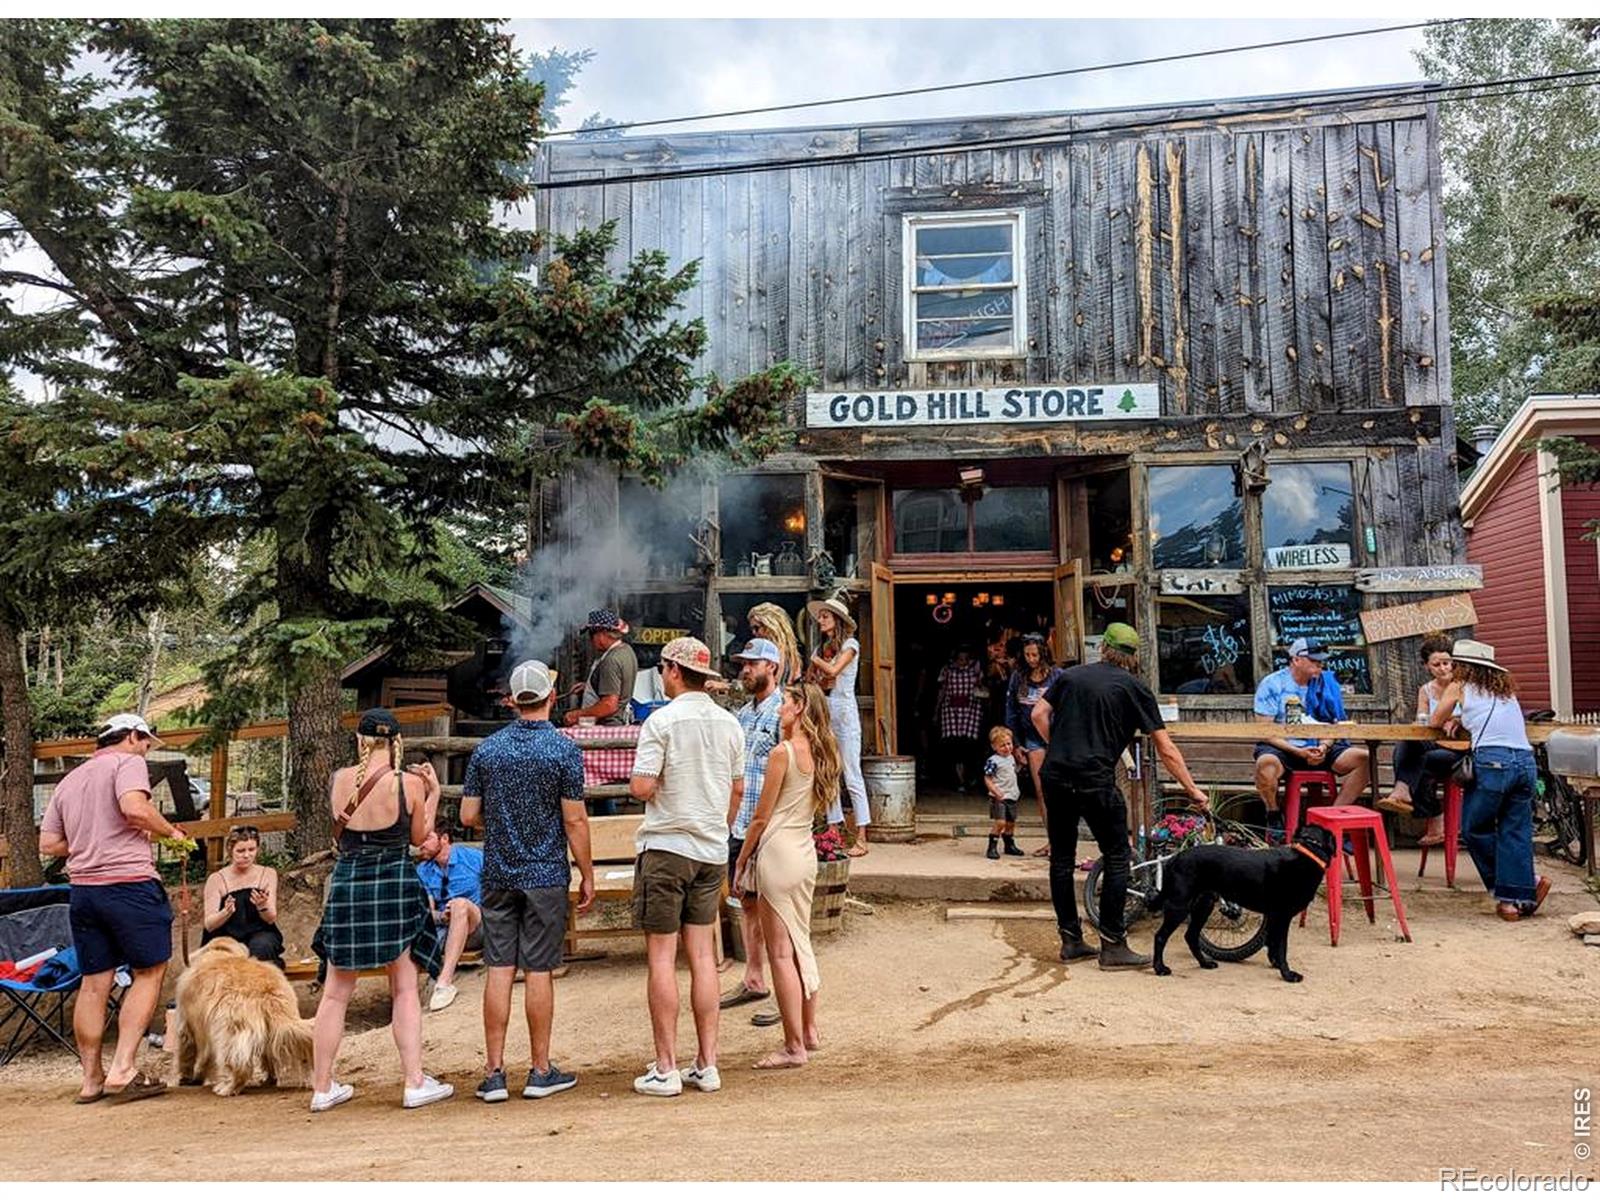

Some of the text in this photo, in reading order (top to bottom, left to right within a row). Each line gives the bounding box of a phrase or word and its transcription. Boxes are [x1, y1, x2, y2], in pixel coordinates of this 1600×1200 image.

[829, 388, 1104, 422] GOLD HILL STORE
[1276, 546, 1340, 567] WIRELESS
[642, 629, 680, 644] OPEN
[1327, 657, 1366, 673] MARY!
